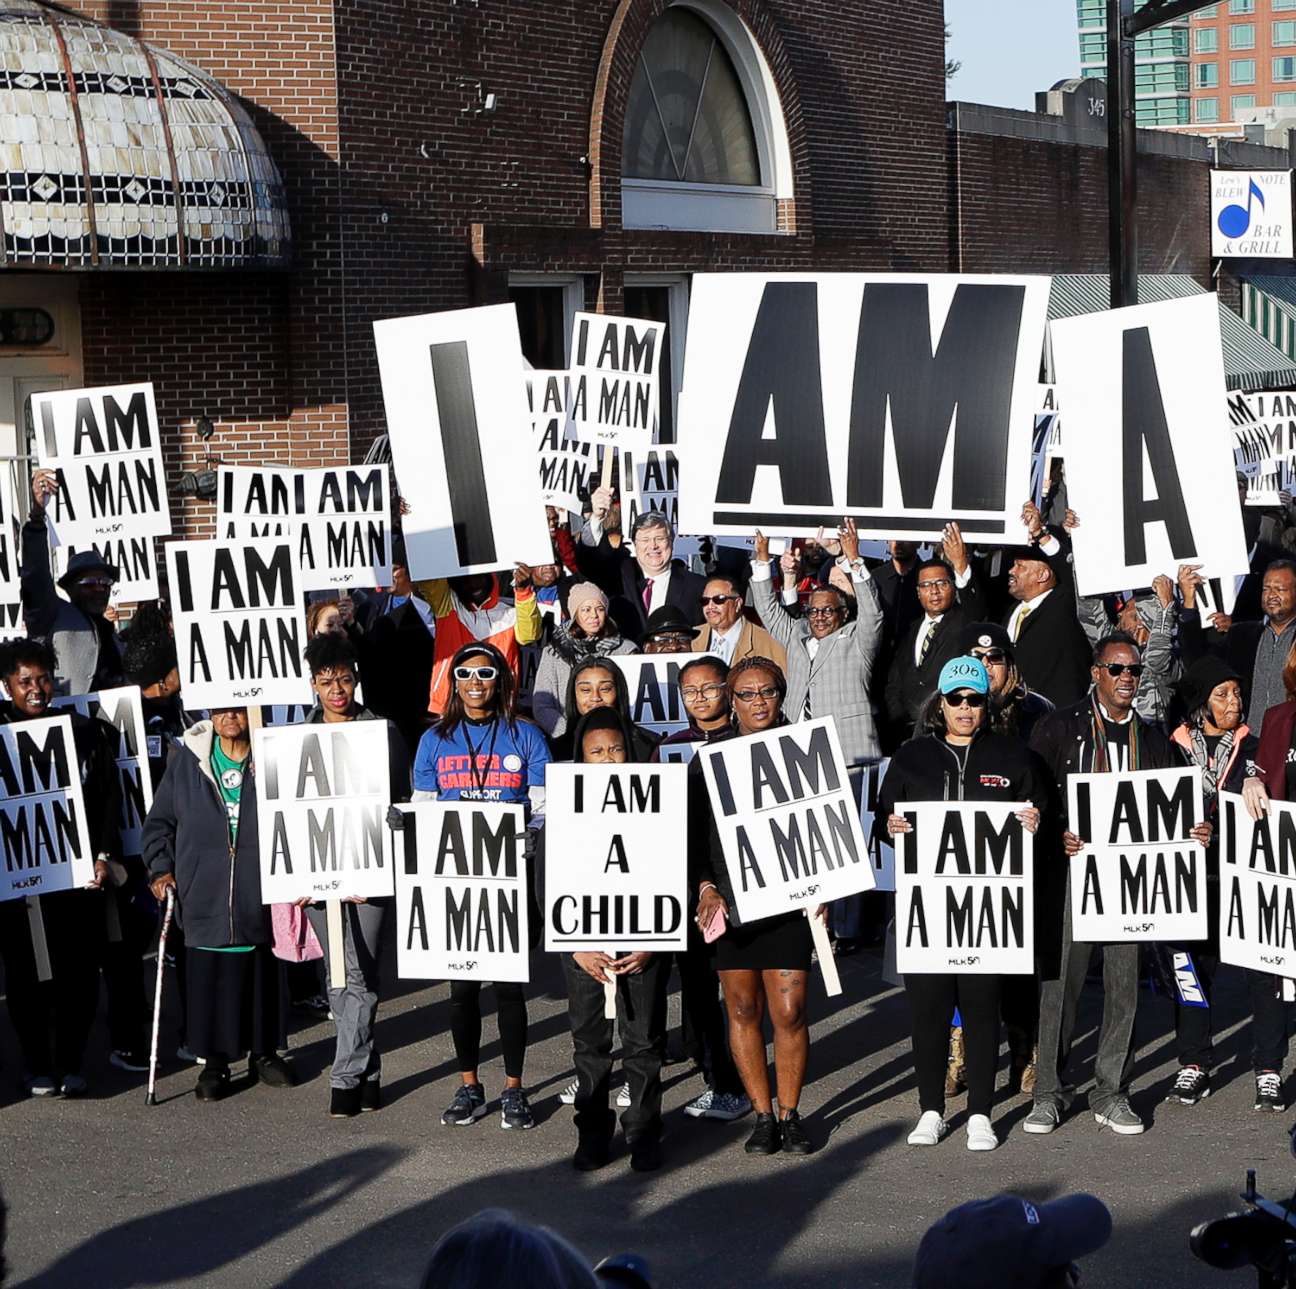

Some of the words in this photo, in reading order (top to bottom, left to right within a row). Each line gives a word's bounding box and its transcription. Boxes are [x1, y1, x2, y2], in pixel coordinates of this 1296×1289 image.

[1087, 97, 1105, 117] 345
[1258, 173, 1287, 186] NOTE
[1223, 241, 1234, 255] &
[1238, 240, 1282, 255] GRILL
[1253, 225, 1283, 238] BAR
[577, 320, 589, 366] I
[597, 323, 657, 374] AM
[41, 402, 58, 457] I
[74, 392, 151, 455] AM
[572, 375, 586, 421] A
[598, 378, 650, 429] MAN
[715, 282, 1026, 511] AM
[430, 341, 497, 568] I
[1122, 326, 1198, 571] A
[55, 468, 76, 523] A
[85, 458, 160, 518] MAN
[294, 474, 305, 514] I
[318, 469, 383, 513] AM
[300, 523, 315, 569] A
[327, 520, 385, 568] MAN
[175, 551, 194, 612] I
[211, 545, 295, 610] AM
[190, 623, 212, 683] A
[223, 617, 302, 680] MAN
[950, 665, 979, 679] 306
[575, 775, 583, 813] I
[602, 775, 660, 813] AM
[709, 752, 737, 816] I
[751, 726, 845, 809] AM
[1078, 783, 1092, 843] I
[1109, 776, 1195, 843] AM
[1226, 801, 1236, 864] I
[271, 811, 293, 875] A
[308, 808, 384, 872] MAN
[403, 812, 418, 875] I
[435, 811, 518, 875] AM
[604, 835, 629, 873] A
[736, 825, 766, 892] A
[769, 800, 859, 882] MAN
[904, 811, 917, 874] I
[935, 811, 1023, 875] AM
[1081, 855, 1104, 915] A
[1120, 851, 1197, 914] MAN
[1228, 876, 1245, 939] A
[407, 886, 429, 950] A
[446, 887, 519, 953] MAN
[552, 895, 681, 935] CHILD
[906, 886, 928, 947] A
[946, 886, 1024, 948] MAN
